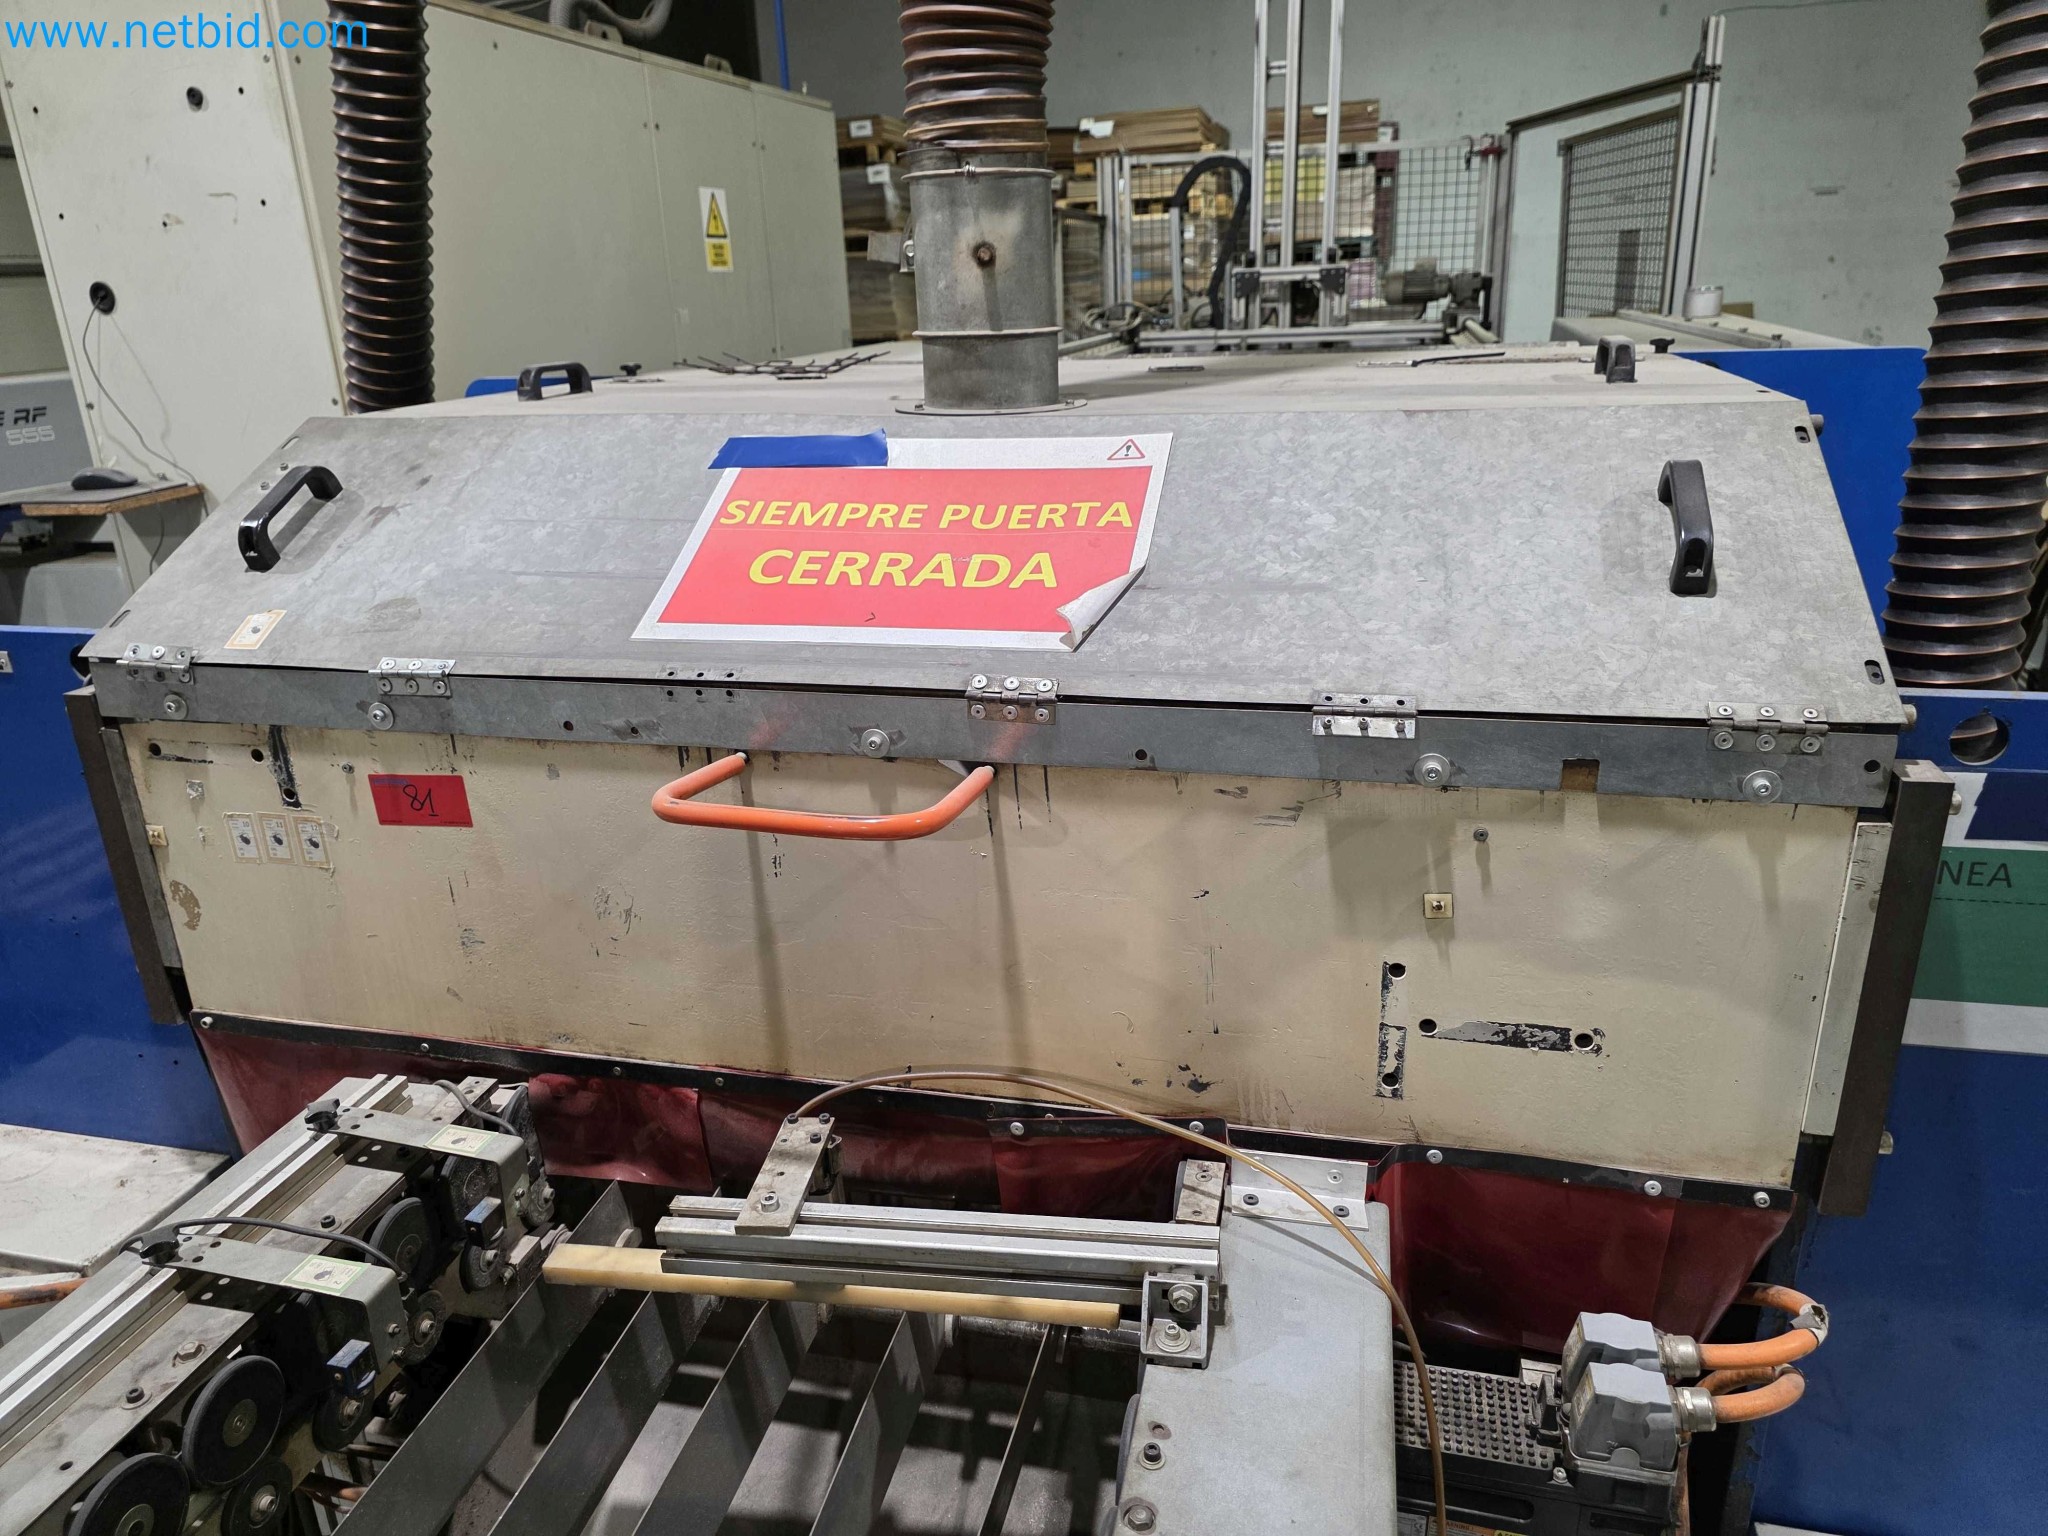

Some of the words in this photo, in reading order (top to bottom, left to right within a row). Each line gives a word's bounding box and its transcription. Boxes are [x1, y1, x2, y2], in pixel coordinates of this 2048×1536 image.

[13, 406, 47, 425] RF
[719, 500, 927, 529] SIEMPRE
[938, 501, 1134, 530] PUERTA
[748, 549, 1058, 589] CERRADA
[402, 784, 439, 817] 81
[1937, 860, 2012, 888] NEA
